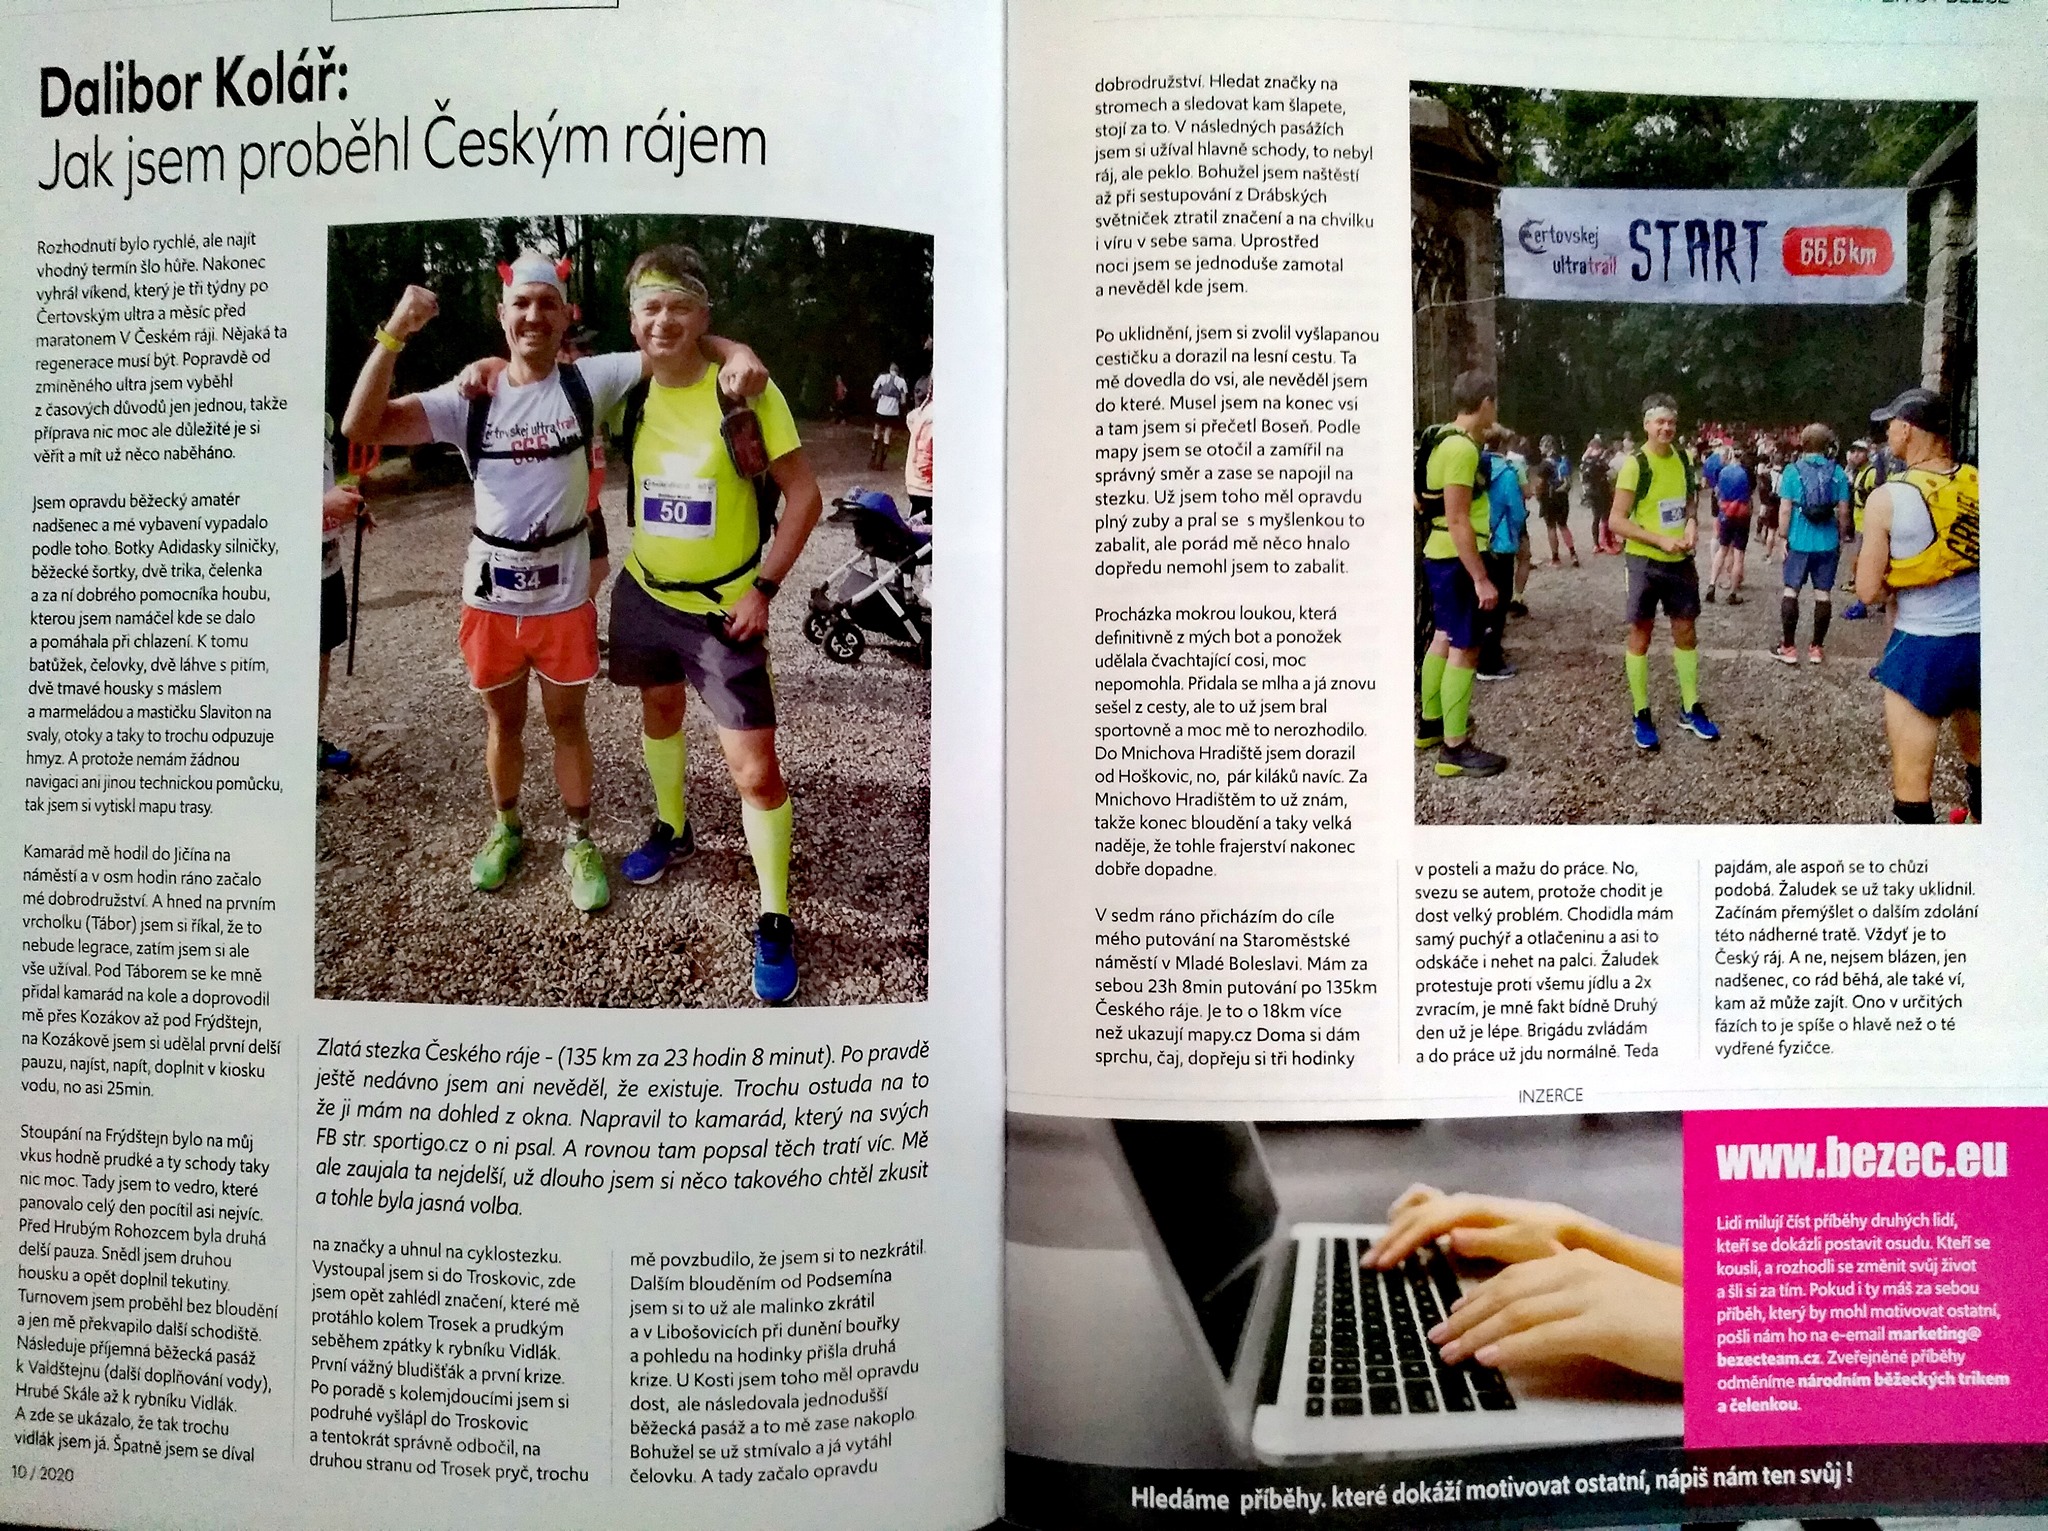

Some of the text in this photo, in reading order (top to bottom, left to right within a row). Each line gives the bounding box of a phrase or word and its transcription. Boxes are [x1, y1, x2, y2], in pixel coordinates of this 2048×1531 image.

[41, 44, 347, 118] Dalibor Kolář:
[1095, 73, 1337, 94] dobrodružství. Hledat značky na
[39, 98, 765, 201] Jak jsem proběhl Českým rájem
[38, 231, 256, 255] Rozhodnutí bylo rychlé, ale najít
[1628, 217, 1769, 285] START
[37, 255, 265, 280] vhodný termín šlo hůře. Nakonec
[1552, 254, 1617, 276] ultratrail
[1096, 324, 1378, 345] Po uklidnění, jsem si zvolil vyšlapanou
[32, 492, 240, 514] Jsem opravdu běžecký amatér
[660, 500, 688, 523] 50
[513, 571, 541, 591] 34
[1096, 604, 1336, 623] Procházka mokrou loukou, která
[24, 844, 230, 865] Kamarád mě hodil do Jičína na
[1415, 860, 1637, 880] v posteli a mažu do práce. No,
[1715, 858, 1927, 878] pajdám, ale aspoň se to chůzi
[1095, 907, 1334, 927] V sedm ráno přicházím do cíle
[317, 1037, 361, 1058] Zlatá
[366, 1040, 420, 1060] stezka
[426, 1039, 501, 1063] Českého
[506, 1046, 540, 1070] ráje
[559, 1046, 597, 1071] (135
[602, 1046, 631, 1066] km
[637, 1053, 659, 1067] za
[664, 1049, 688, 1067] 23
[693, 1046, 746, 1067] hodin
[752, 1047, 764, 1066] 8
[770, 1044, 834, 1069] minut).
[841, 1044, 863, 1063] Po
[868, 1039, 929, 1067] pravdě
[1715, 1039, 1833, 1060] vydřené fyzičce.
[314, 1067, 929, 1103] ještě nedávno jsem ani nevěděl, že existuje. Trochu ostuda na to
[1519, 1088, 1583, 1103] INZERCE
[21, 1123, 253, 1154] Stoupání na Frýdštejn bylo na můj
[1716, 1135, 2008, 1181] www.bezec.eu
[316, 1187, 521, 1216] a tohle byla jasná volba.
[1717, 1212, 1958, 1233] Lidi milují číst příběhy druhých lidí,
[313, 1237, 561, 1264] na značky a uhnul na cyklostezku.
[312, 1260, 575, 1290] Vystoupal jsem si do Troskovic, zde
[631, 1268, 891, 1291] Dalším blouděním od Podsemína
[12, 1464, 27, 1479] 10
[40, 1465, 74, 1483] 2020
[630, 1458, 877, 1486] čelovku. A tady začalo opravdu
[1132, 1485, 1229, 1510] Hledáme
[1332, 1483, 1387, 1508] které
[1392, 1479, 1462, 1505] dokáží
[1466, 1475, 1570, 1501] motivovat
[1575, 1468, 1650, 1495] ostatní,
[1656, 1465, 1708, 1494] nápiš
[1714, 1465, 1758, 1488] nám
[1762, 1466, 1796, 1486] ten
[1800, 1461, 1841, 1490] svůj
